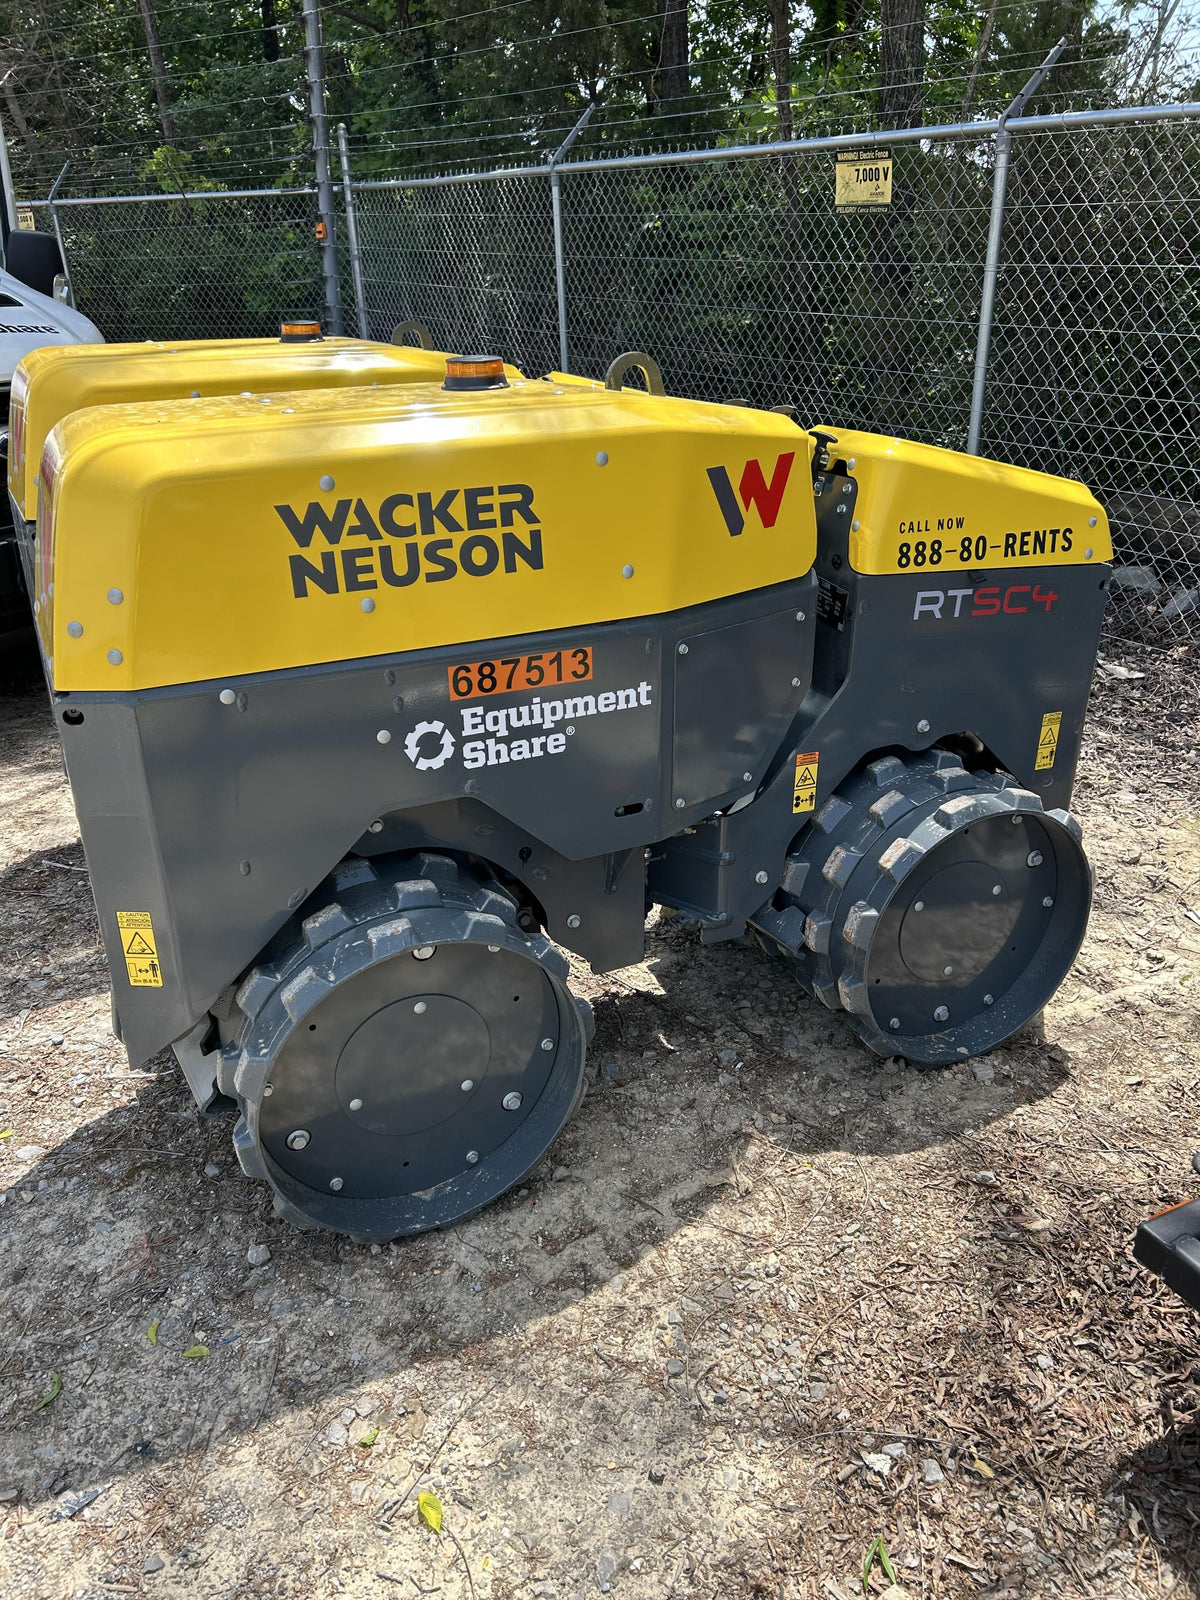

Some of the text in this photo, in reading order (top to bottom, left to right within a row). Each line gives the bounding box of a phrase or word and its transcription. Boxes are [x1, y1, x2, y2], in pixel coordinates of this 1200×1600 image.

[854, 166, 889, 184] 7,000 V
[860, 151, 875, 159] Electric
[875, 150, 889, 158] Fence
[274, 483, 541, 548] WACKER
[899, 517, 965, 534] CALL NOW
[288, 529, 544, 599] NEUSON
[897, 527, 1074, 568] 888-80-RENTS
[913, 585, 1059, 620] RTSC4
[451, 648, 590, 697] 687513
[460, 681, 652, 737] Equipment
